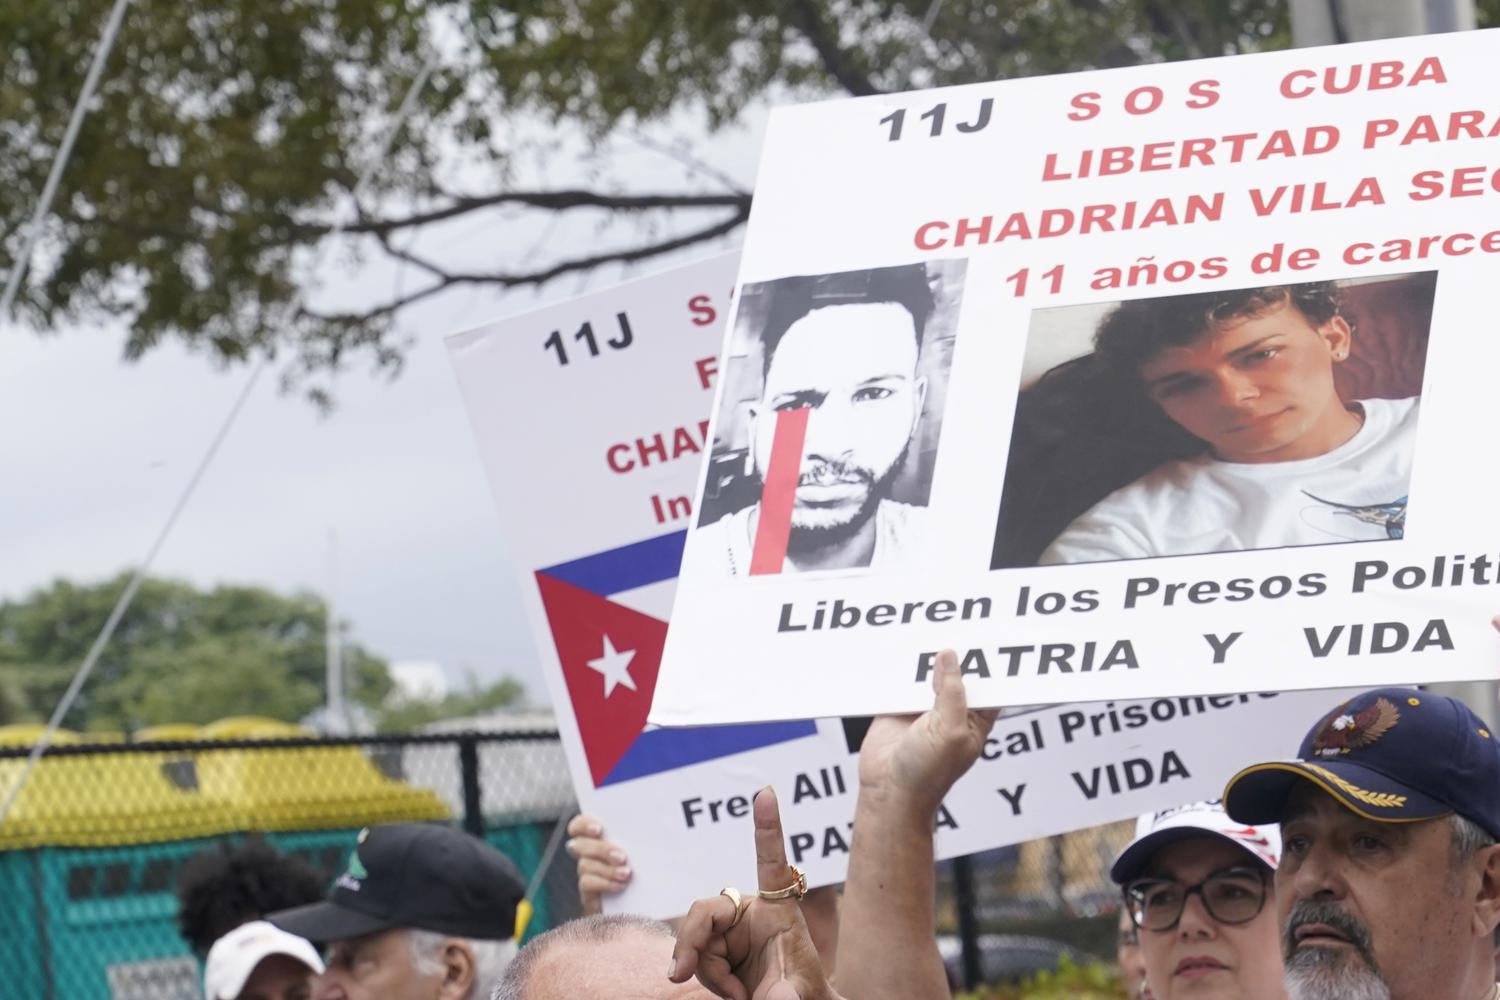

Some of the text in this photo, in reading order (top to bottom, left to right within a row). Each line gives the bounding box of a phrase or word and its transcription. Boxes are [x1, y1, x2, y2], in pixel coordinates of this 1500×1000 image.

[1279, 56, 1448, 99] CUBA
[878, 98, 994, 142] 11J
[1042, 126, 1340, 182] LIBERTAD
[914, 191, 1225, 251] CHADRIAN
[1249, 177, 1385, 217] VILA
[1006, 264, 1065, 298] 11
[1090, 256, 1229, 290] años
[1251, 243, 1320, 275] de
[543, 311, 635, 366] 11J
[606, 419, 709, 474] CHA
[777, 597, 992, 634] Liberen
[1016, 585, 1099, 617] los
[1124, 572, 1327, 610] Presos
[1203, 632, 1243, 664] Y
[1303, 618, 1455, 659] VIDA
[682, 788, 762, 829] Fre
[793, 765, 846, 804] All
[997, 784, 1027, 816] Y
[1071, 750, 1191, 800] VIDA
